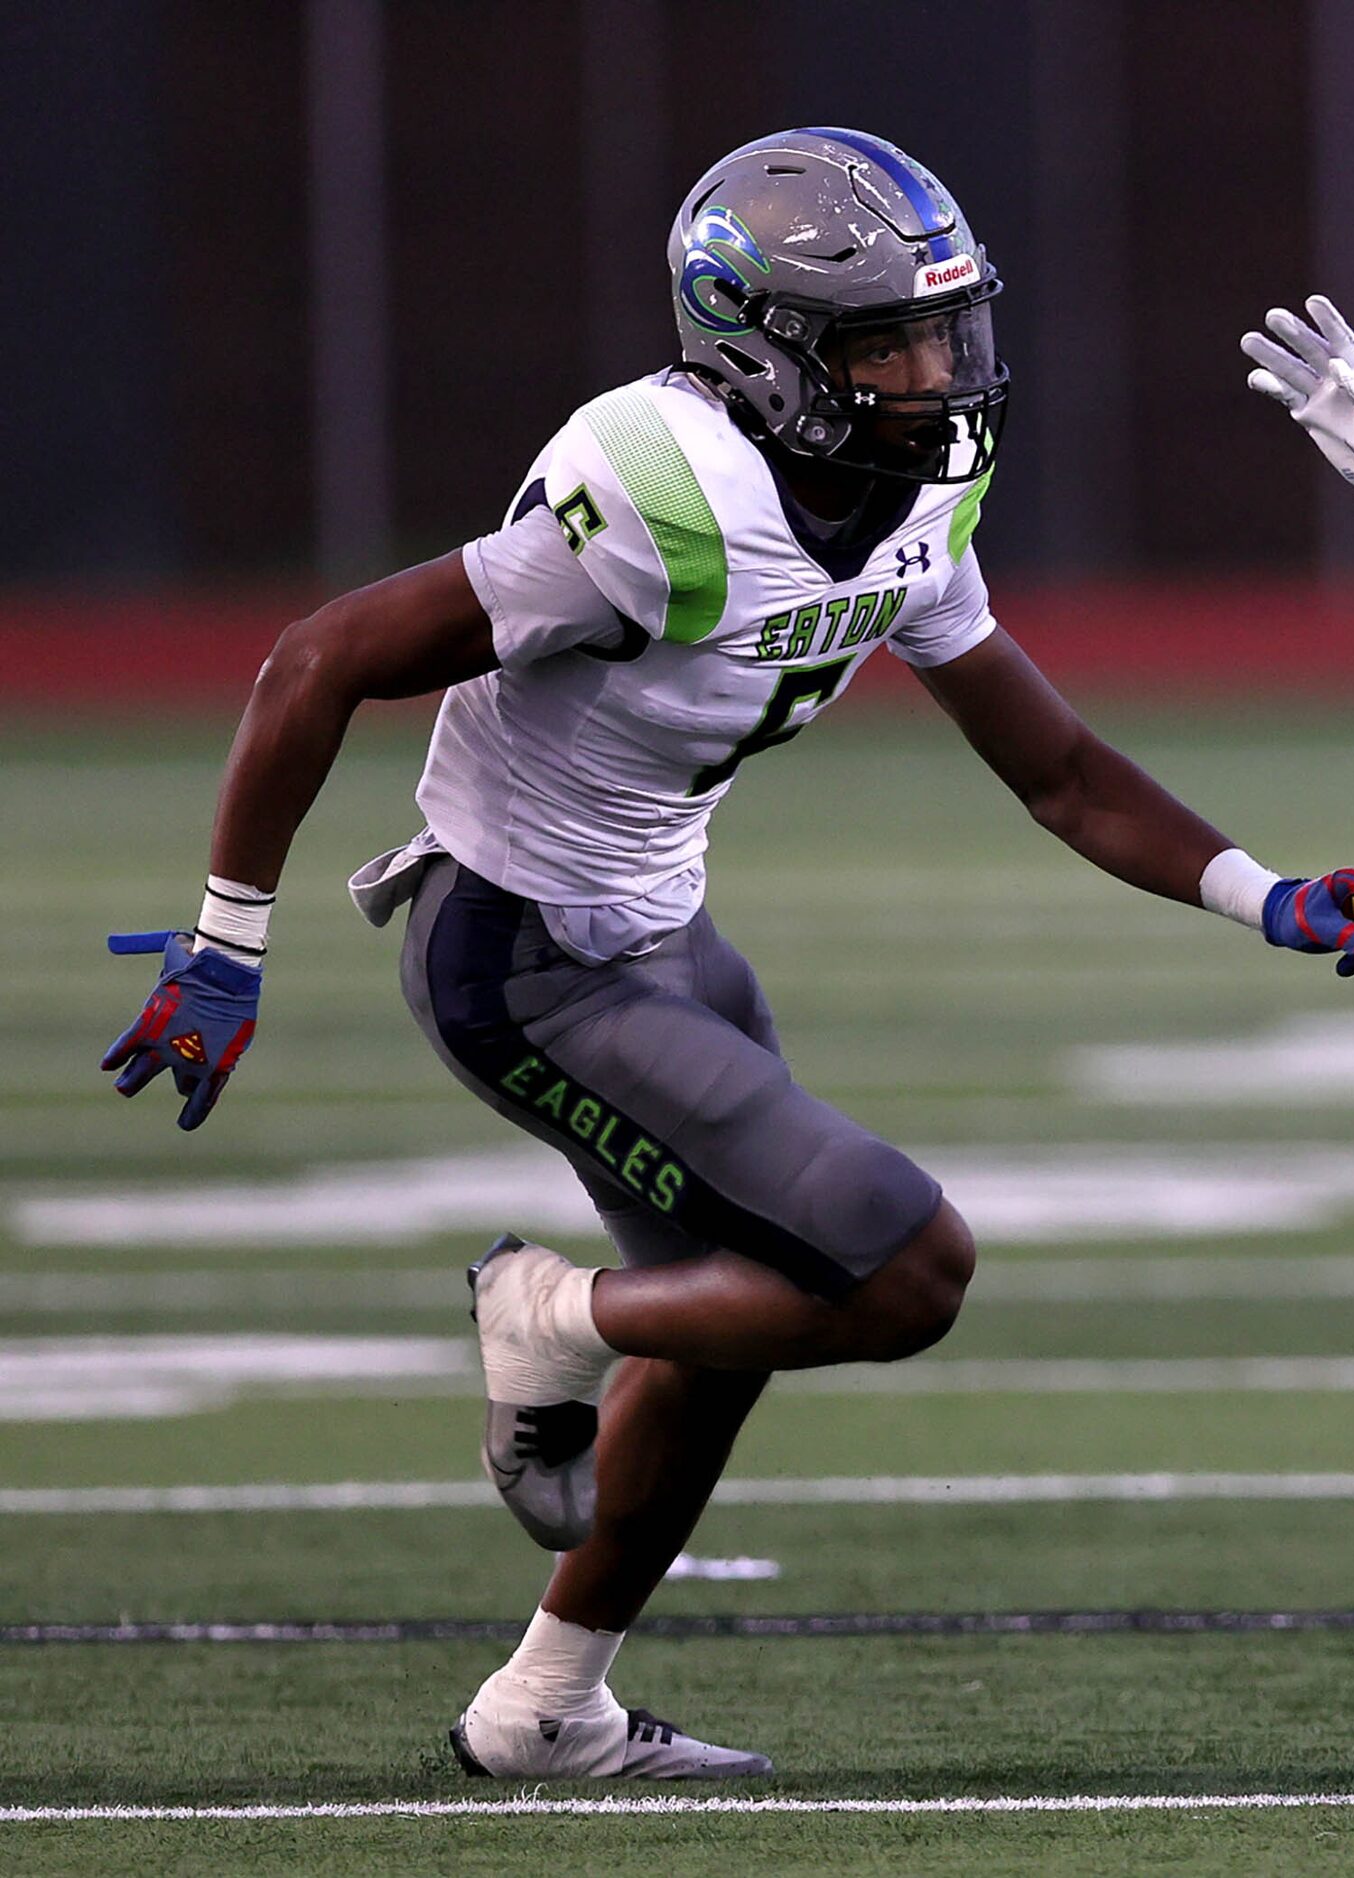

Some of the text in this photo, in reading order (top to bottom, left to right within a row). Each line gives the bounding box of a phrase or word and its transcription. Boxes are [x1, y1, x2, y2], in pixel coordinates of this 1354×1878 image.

[925, 259, 974, 287] Riddell
[755, 587, 907, 662] EATON
[500, 1056, 684, 1213] EAGLES
